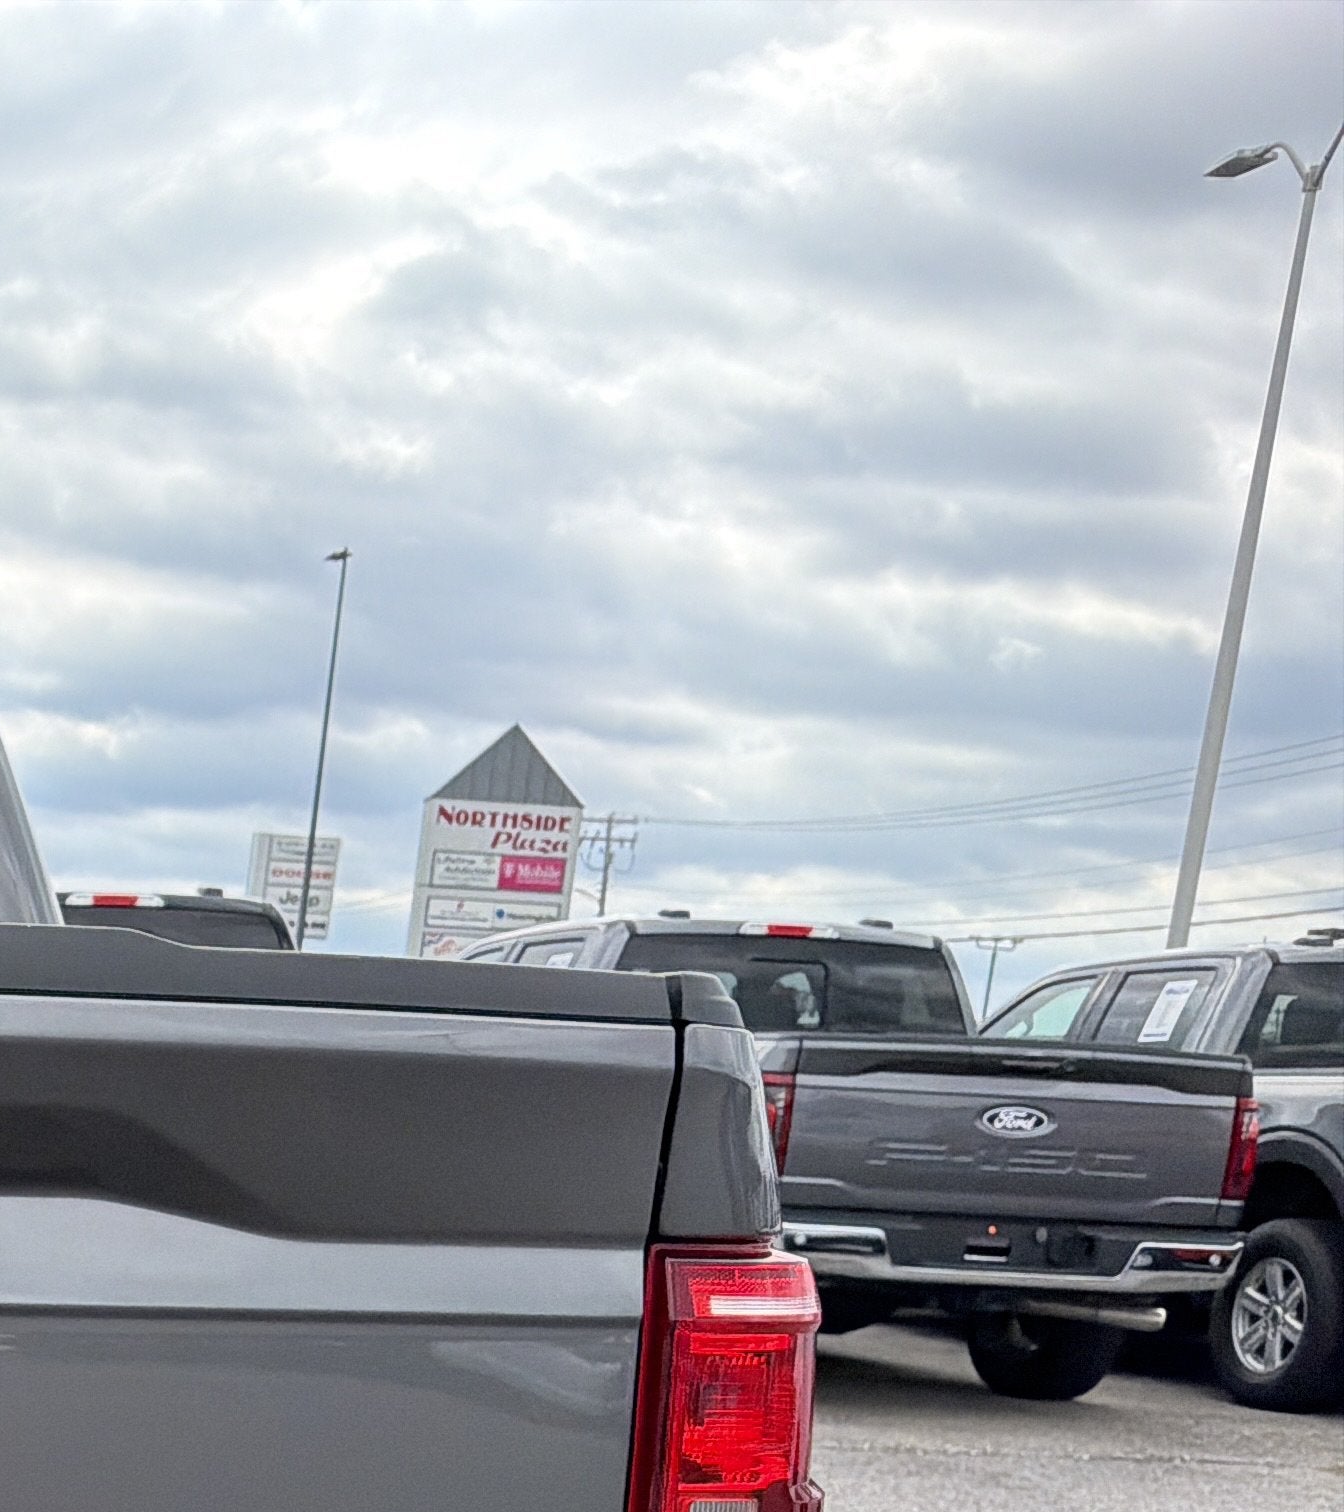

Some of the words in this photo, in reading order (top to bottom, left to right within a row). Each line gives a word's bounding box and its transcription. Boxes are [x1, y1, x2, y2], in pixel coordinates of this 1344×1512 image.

[436, 804, 573, 833] NORTHSIDE
[490, 831, 569, 853] Plaza
[992, 1110, 1039, 1131] Ford
